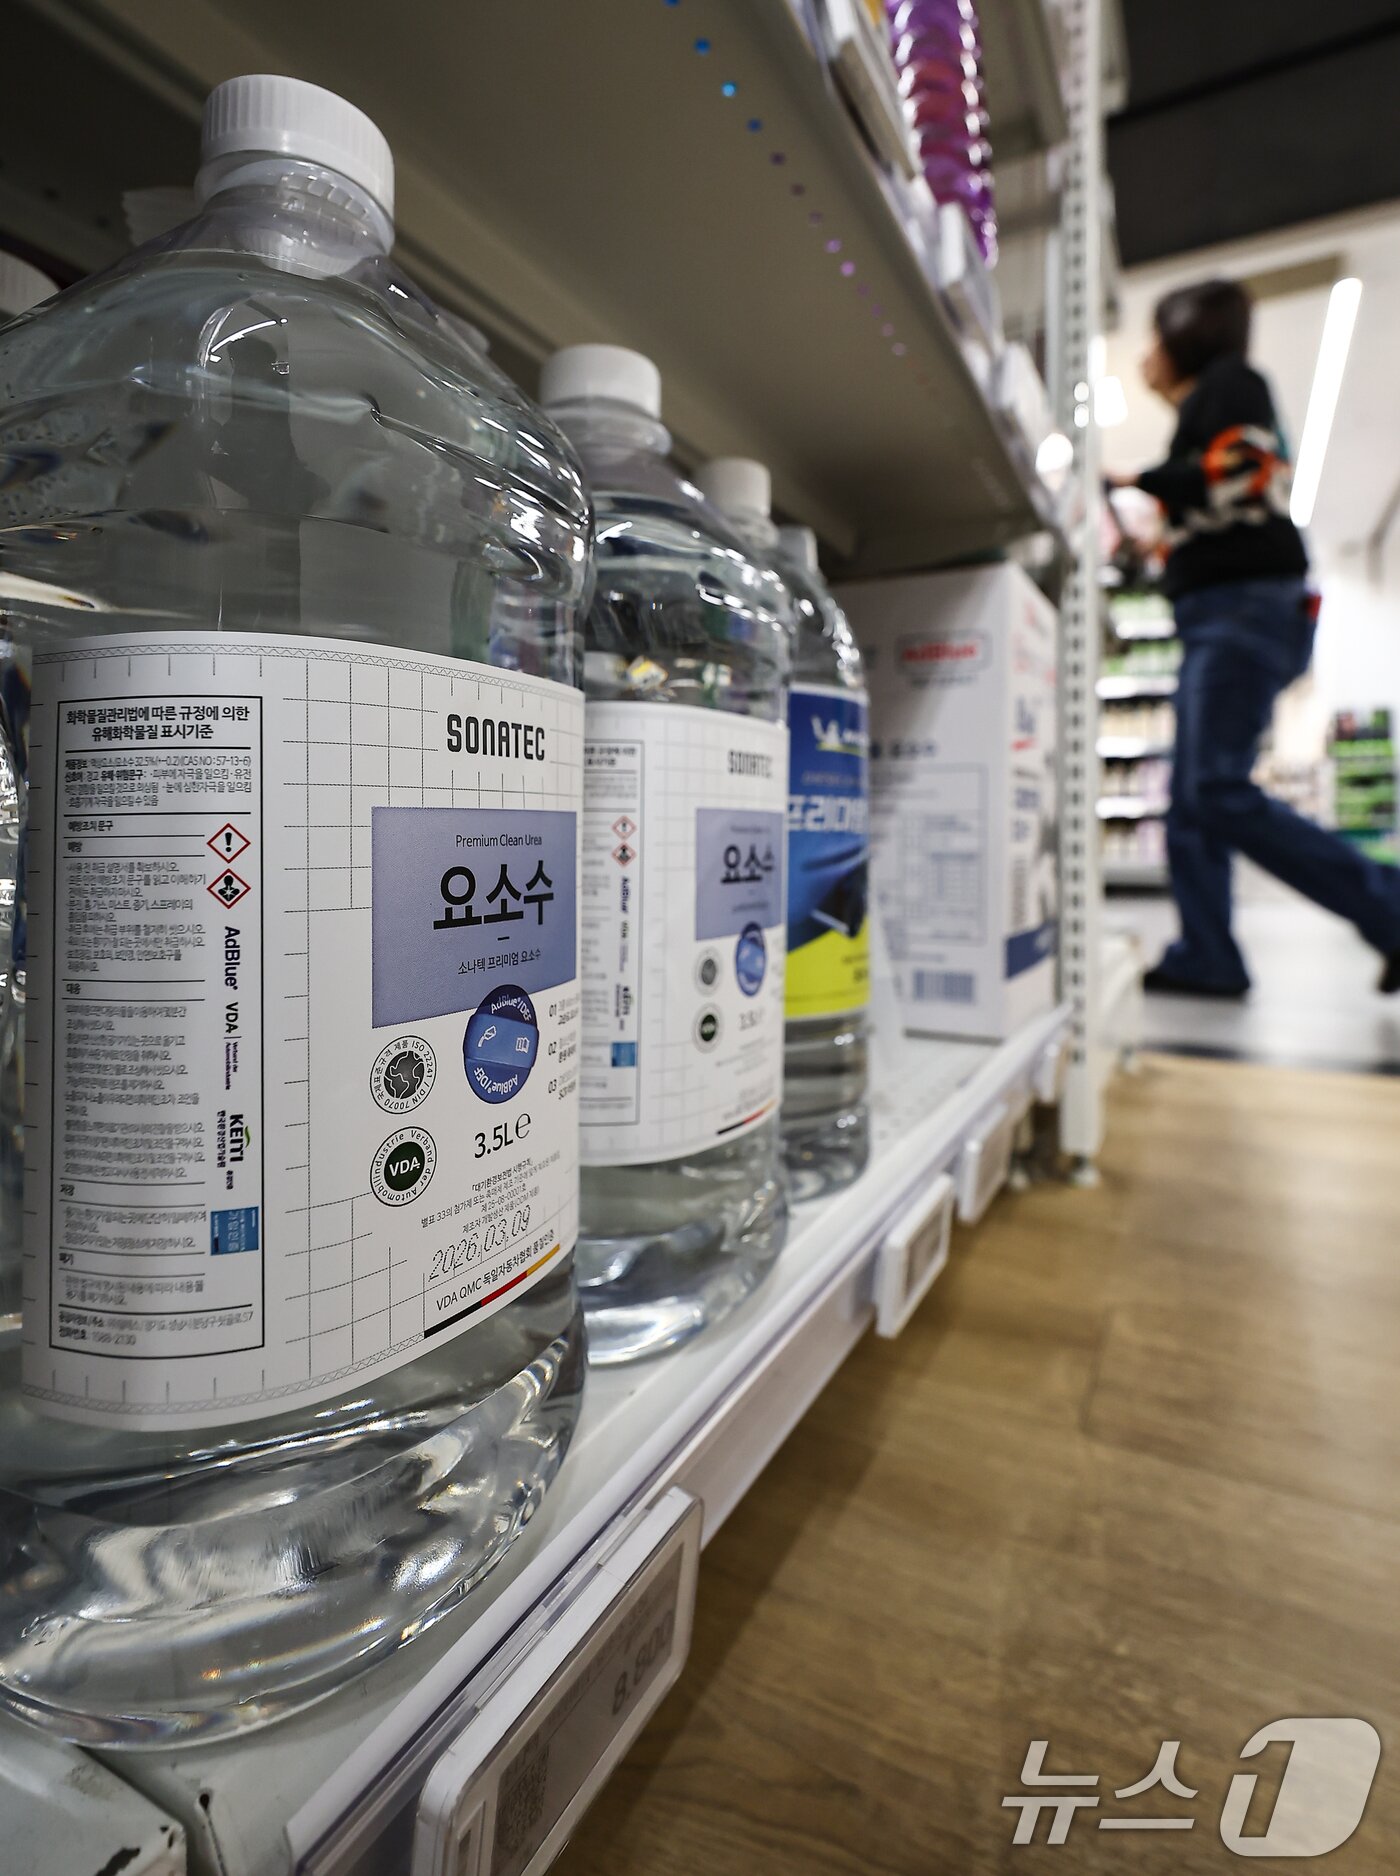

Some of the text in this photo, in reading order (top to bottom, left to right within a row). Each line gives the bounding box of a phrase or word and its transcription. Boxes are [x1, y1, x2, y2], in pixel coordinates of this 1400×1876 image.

[66, 705, 250, 725] 화학물질관리법에 따른 규정에 의한
[91, 724, 214, 741] 유해화학물질 표시기준
[447, 713, 546, 761] SONATEC
[456, 833, 542, 848] Premium Clean Urea
[433, 860, 554, 930] 요소수
[457, 948, 542, 976] 소나텍 프리미엄 요소수
[225, 1002, 240, 1033] VDA
[411, 1040, 425, 1052] ISO
[423, 1050, 434, 1078] 22241
[384, 1098, 410, 1110] 70070
[412, 1088, 426, 1104] DIN
[474, 1122, 513, 1158] 3.5L
[372, 1129, 435, 1201] Verband der Automobilindustrie
[389, 1156, 421, 1177] VDA
[436, 1292, 458, 1311] VDA
[459, 1275, 482, 1299] QMC
